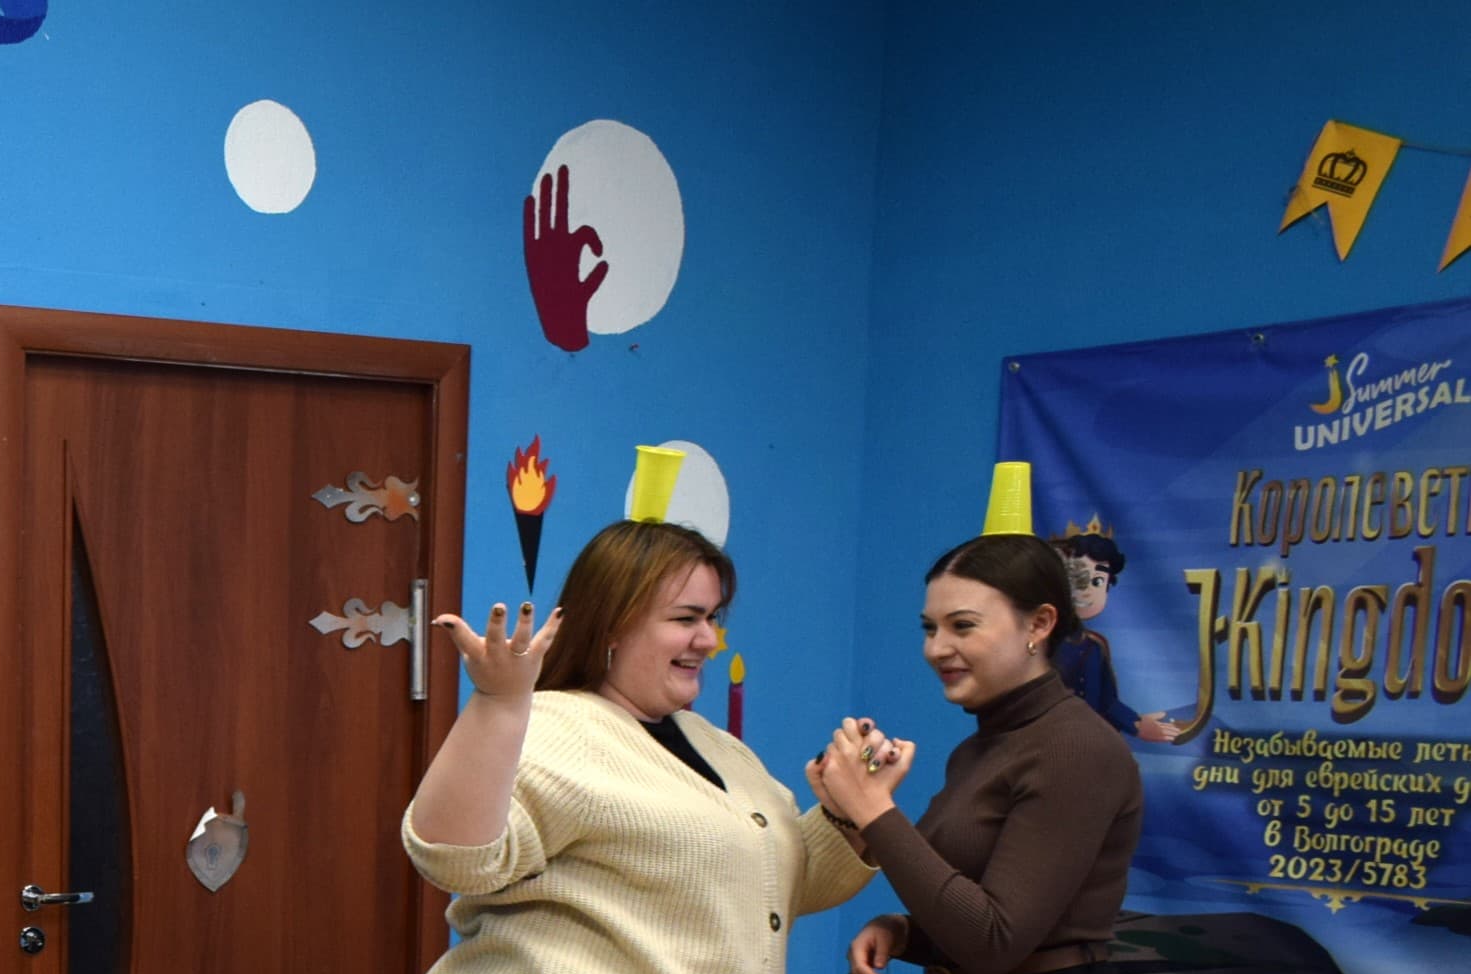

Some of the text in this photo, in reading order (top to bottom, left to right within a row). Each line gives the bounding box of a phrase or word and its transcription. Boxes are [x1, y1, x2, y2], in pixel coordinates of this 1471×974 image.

[1342, 352, 1452, 414] Summer
[1294, 379, 1471, 450] UNIVERSAL
[1230, 466, 1471, 557] Королевст
[1213, 729, 1402, 763] Незабываемые
[1193, 765, 1239, 790] дни
[1252, 768, 1293, 794] для
[1305, 762, 1441, 797] еврейских
[1257, 795, 1455, 828] от 5 до 15 лет
[1264, 820, 1440, 868] в Волгограде
[1268, 854, 1426, 889] 2023/5783
